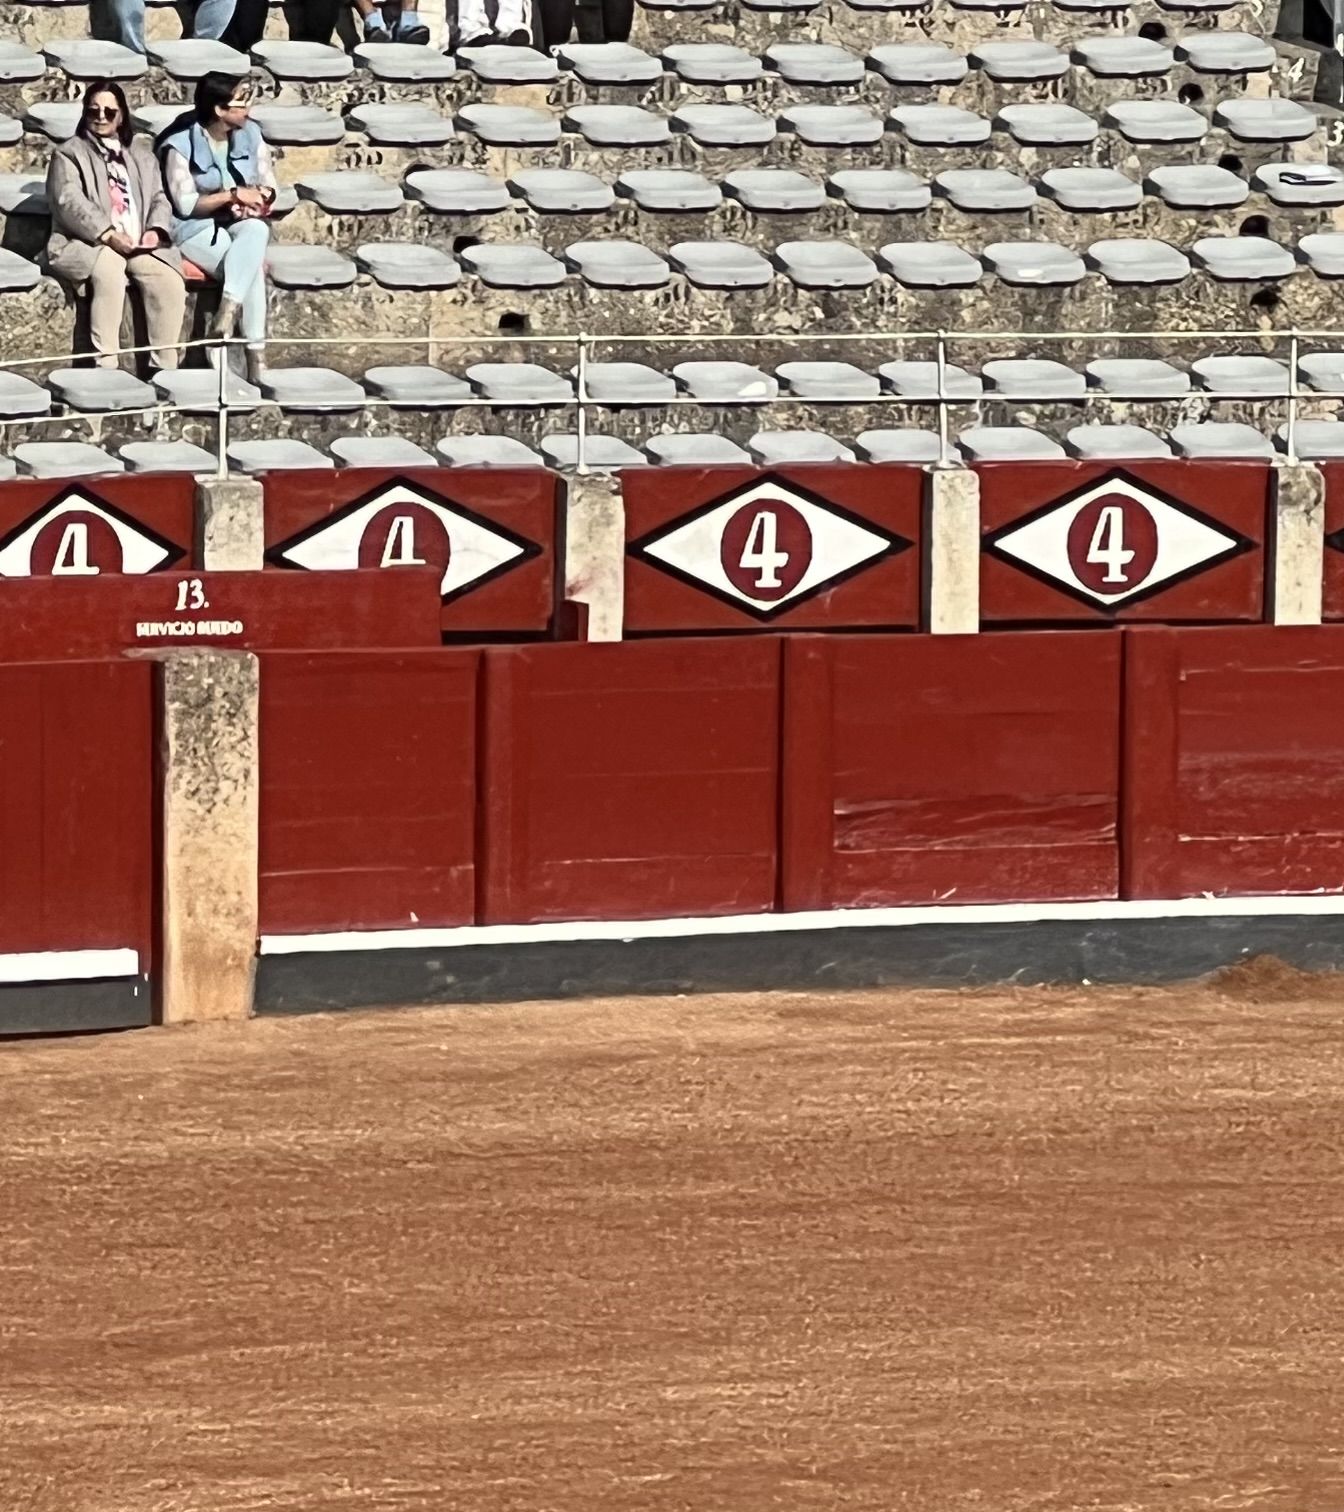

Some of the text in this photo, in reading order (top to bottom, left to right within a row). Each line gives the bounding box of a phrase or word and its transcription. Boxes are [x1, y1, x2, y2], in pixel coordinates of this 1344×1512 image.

[739, 511, 788, 587] 4
[1087, 507, 1135, 582] 4
[175, 578, 210, 611] 13.
